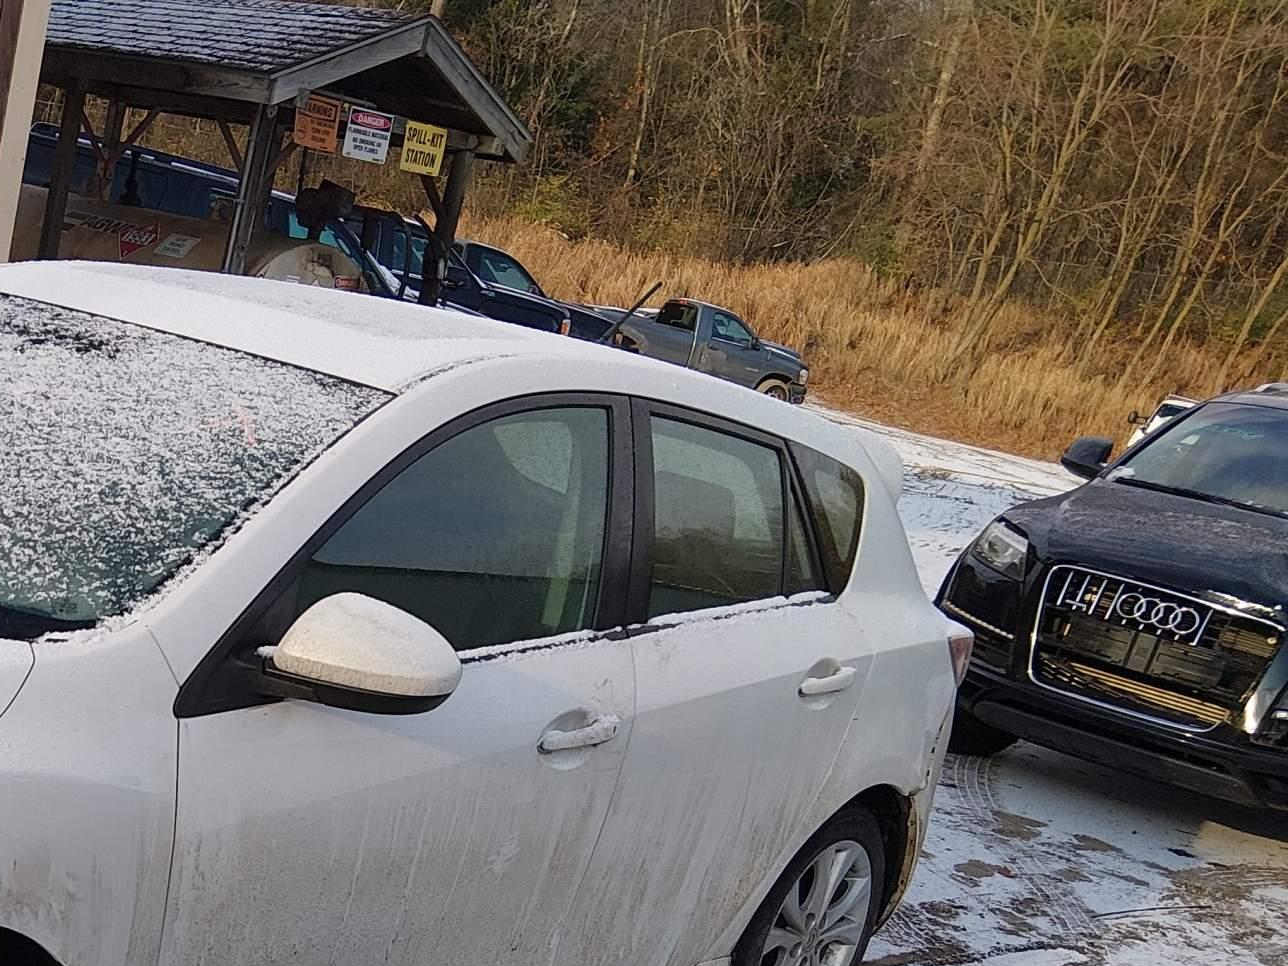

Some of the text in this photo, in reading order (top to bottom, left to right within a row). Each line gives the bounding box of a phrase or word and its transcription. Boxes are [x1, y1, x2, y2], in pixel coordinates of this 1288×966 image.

[358, 113, 385, 127] DANGER
[407, 127, 444, 149] SPILL-KIT
[405, 148, 437, 169] STATION
